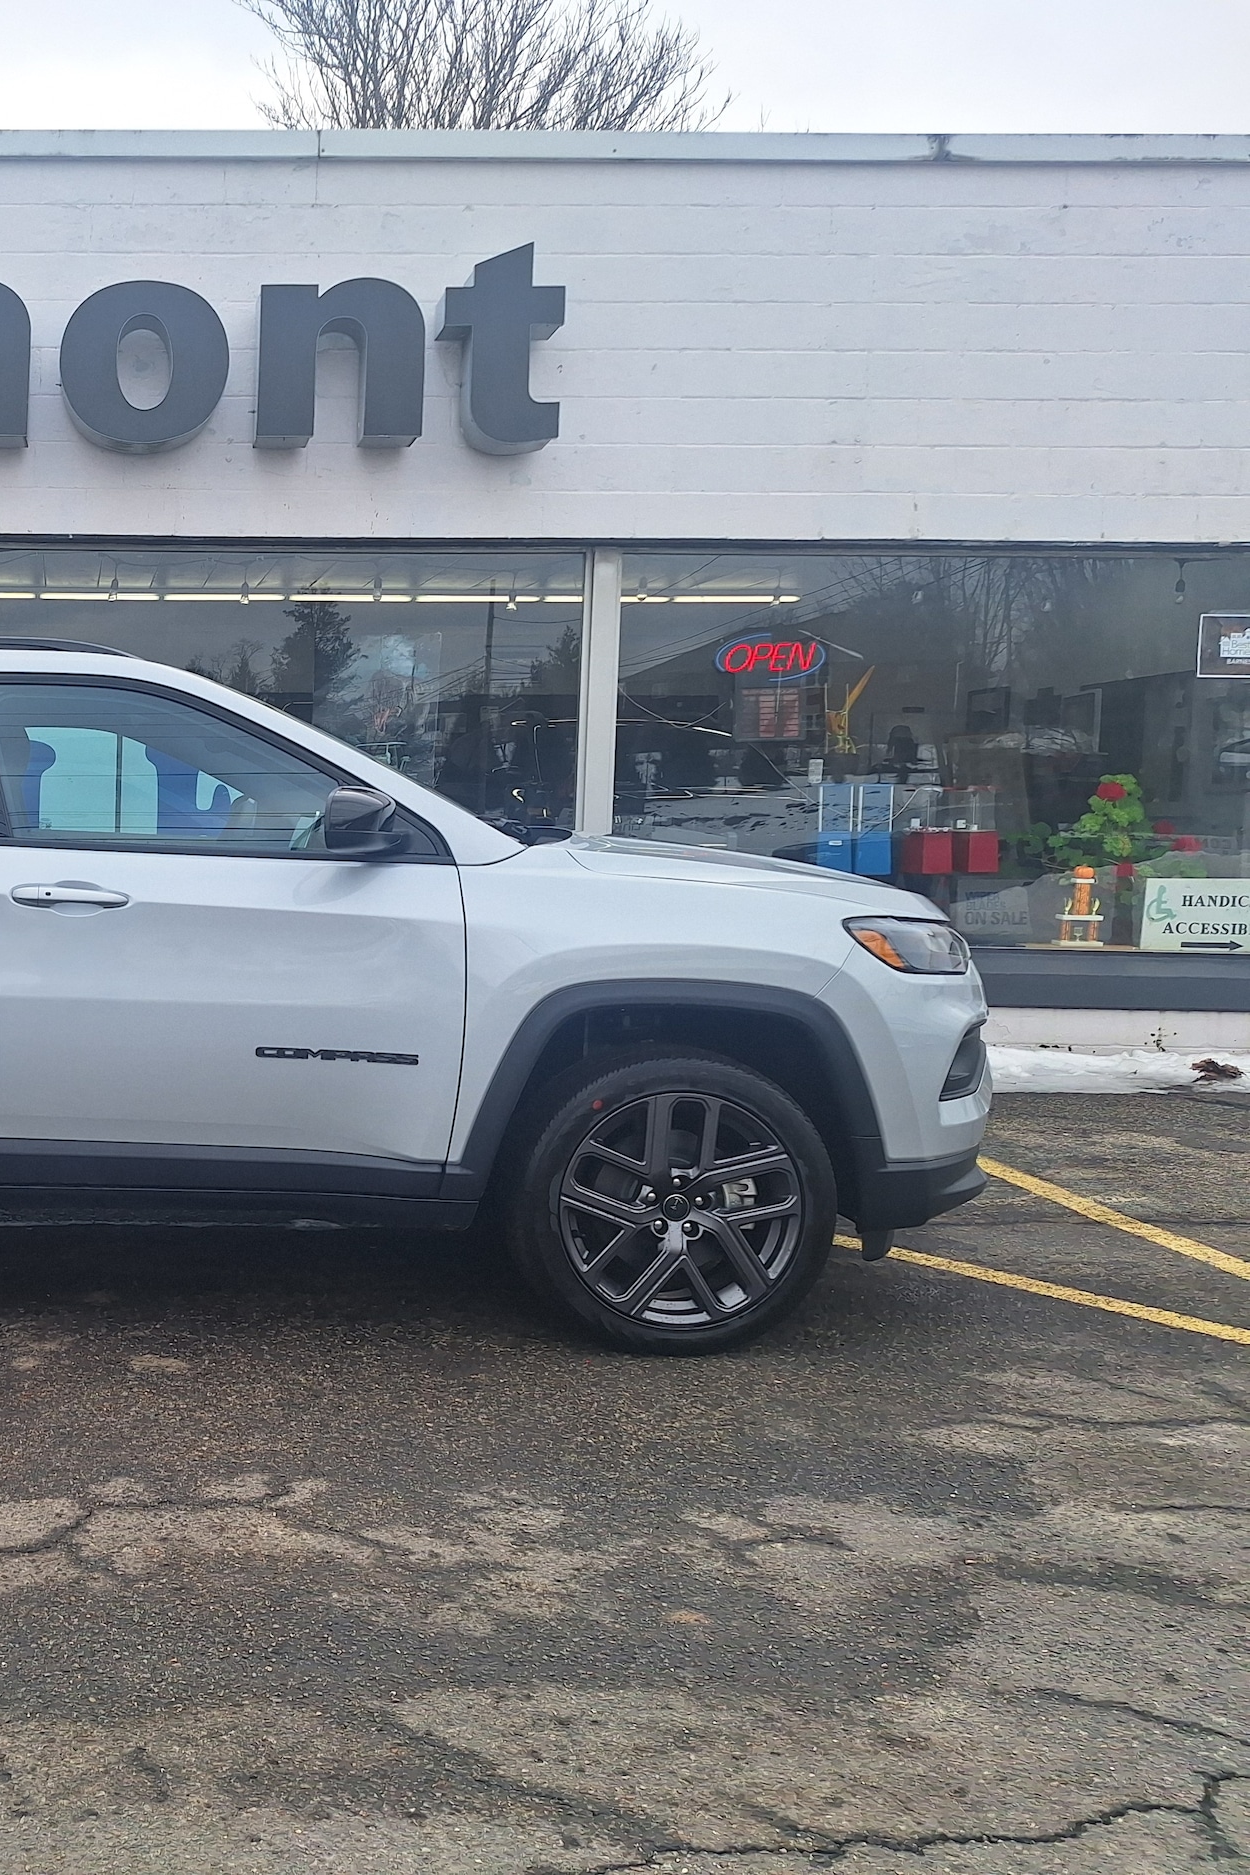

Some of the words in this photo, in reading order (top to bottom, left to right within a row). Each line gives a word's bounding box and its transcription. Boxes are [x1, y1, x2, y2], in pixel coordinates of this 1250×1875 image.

[724, 641, 817, 674] OPEN
[1181, 895, 1250, 908] HANDIC
[965, 911, 987, 926] ON
[990, 911, 1028, 926] SALE
[1162, 921, 1250, 935] ACCESSIB
